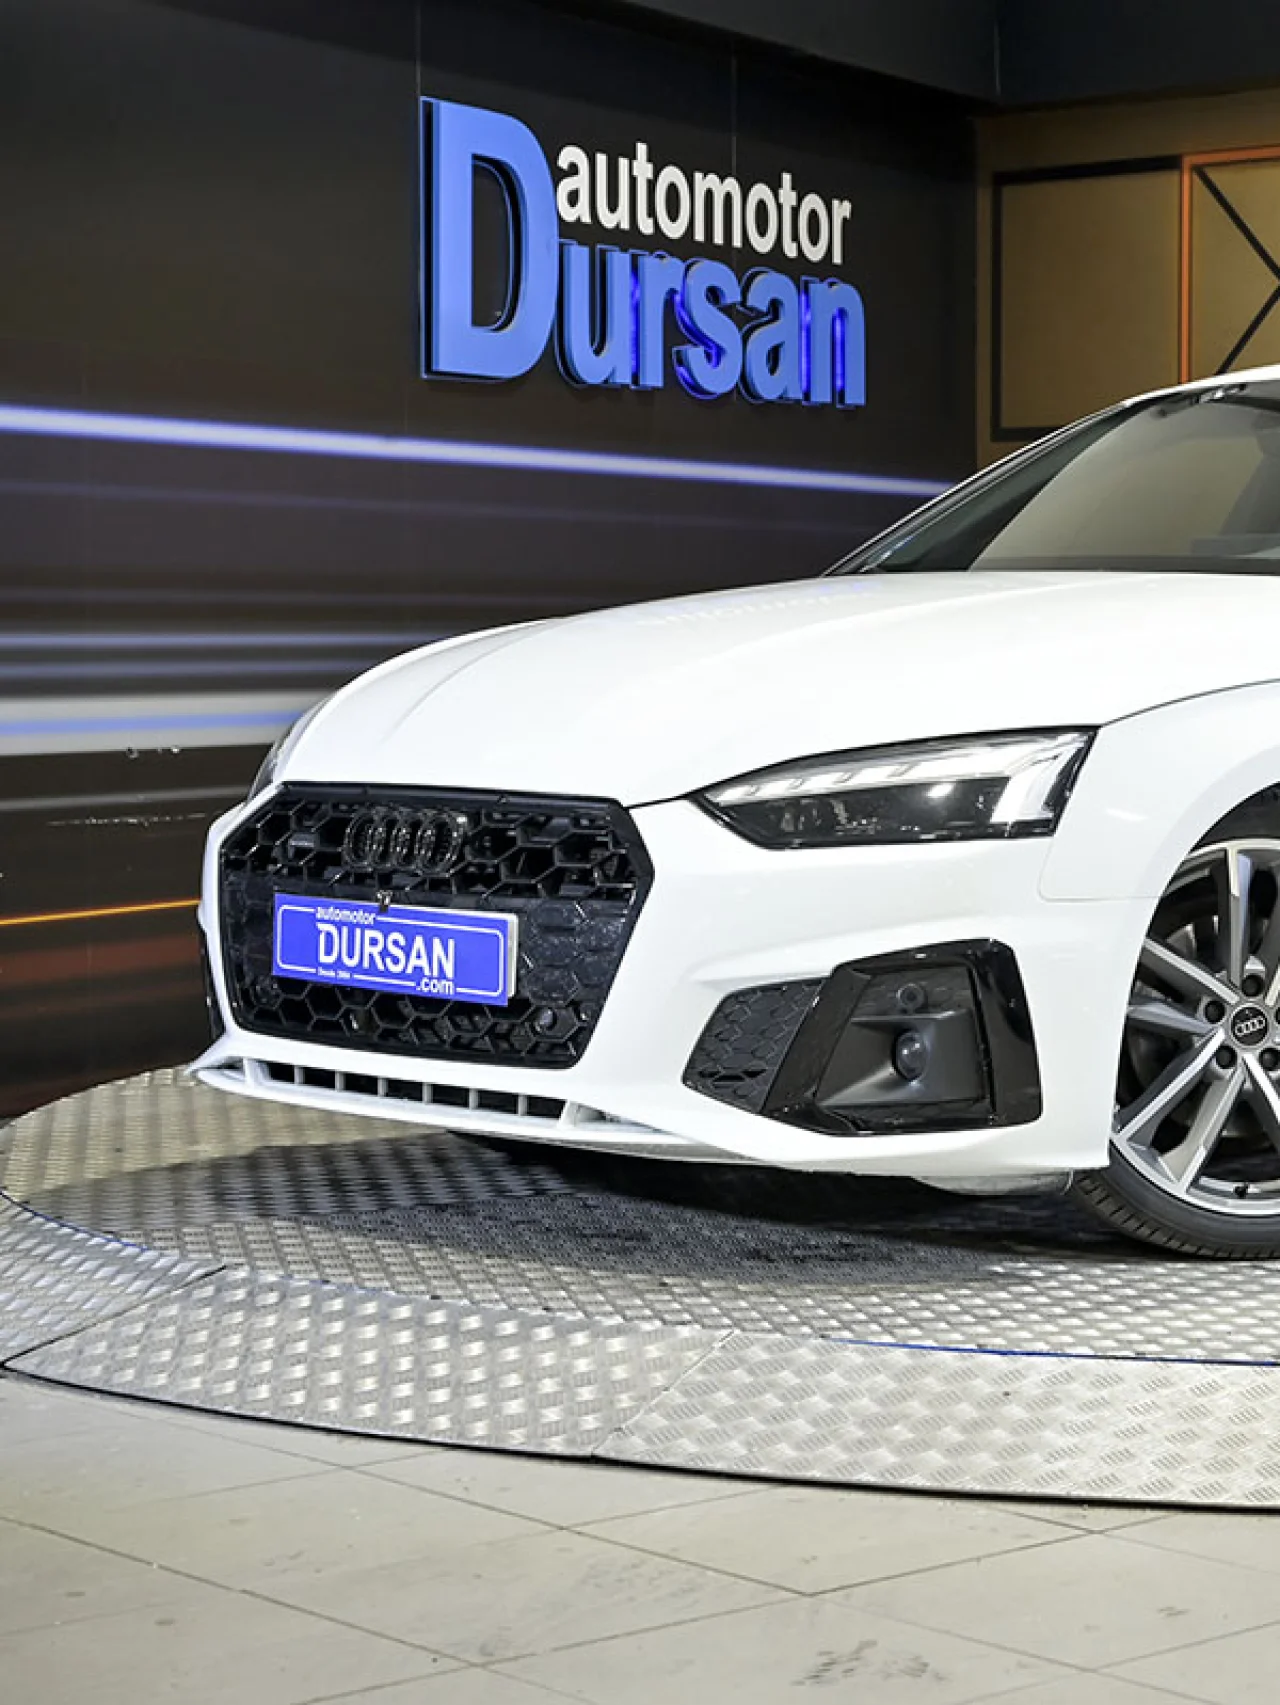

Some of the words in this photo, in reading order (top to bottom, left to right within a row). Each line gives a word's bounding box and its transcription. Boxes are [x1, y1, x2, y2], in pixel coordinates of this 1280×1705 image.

[556, 142, 852, 265] automotor
[420, 97, 867, 408] Dursan
[315, 906, 377, 925] automotor
[316, 922, 456, 978] DURSAN
[415, 976, 455, 995] .com
